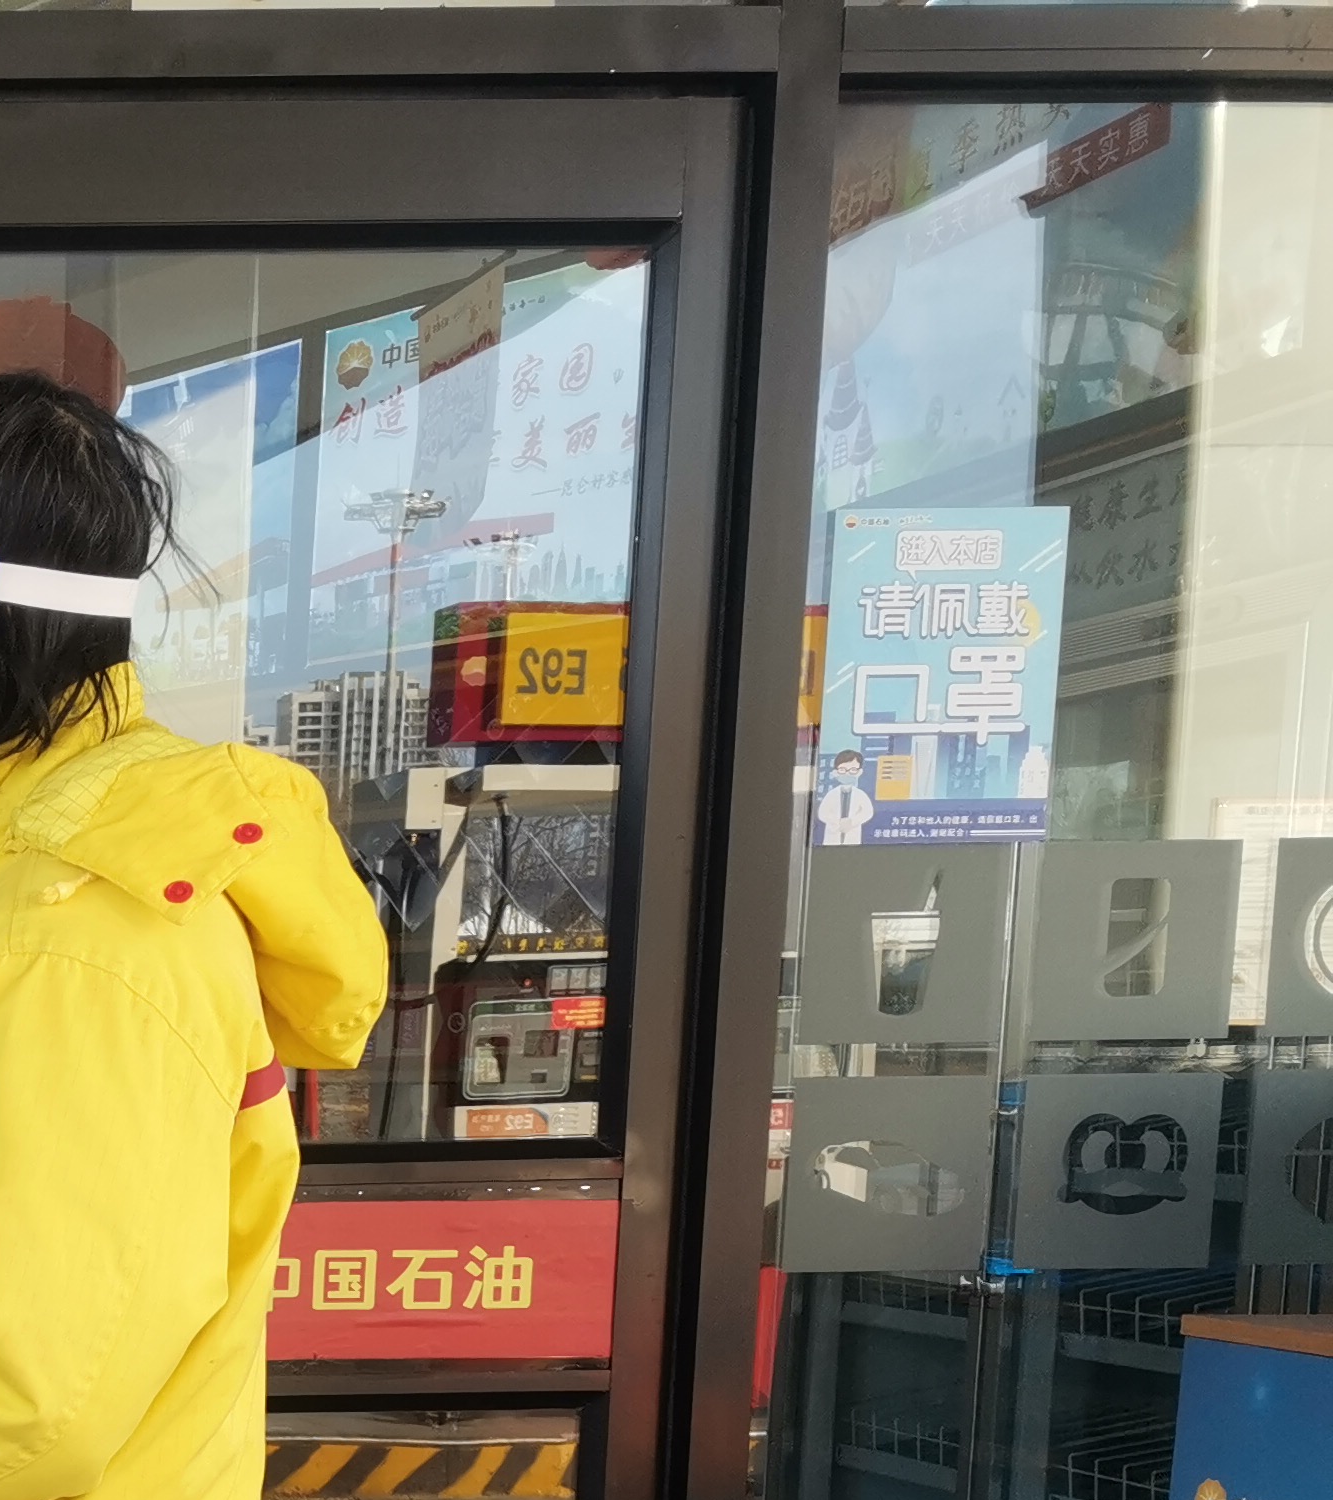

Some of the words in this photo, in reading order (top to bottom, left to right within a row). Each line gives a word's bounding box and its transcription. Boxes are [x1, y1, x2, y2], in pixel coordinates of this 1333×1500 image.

[1040, 111, 1151, 198] 天天实惠
[333, 385, 409, 444] 创造
[899, 535, 1001, 566] 进入本店
[858, 580, 1030, 639] 请佩戴
[852, 646, 1028, 745] 口罩
